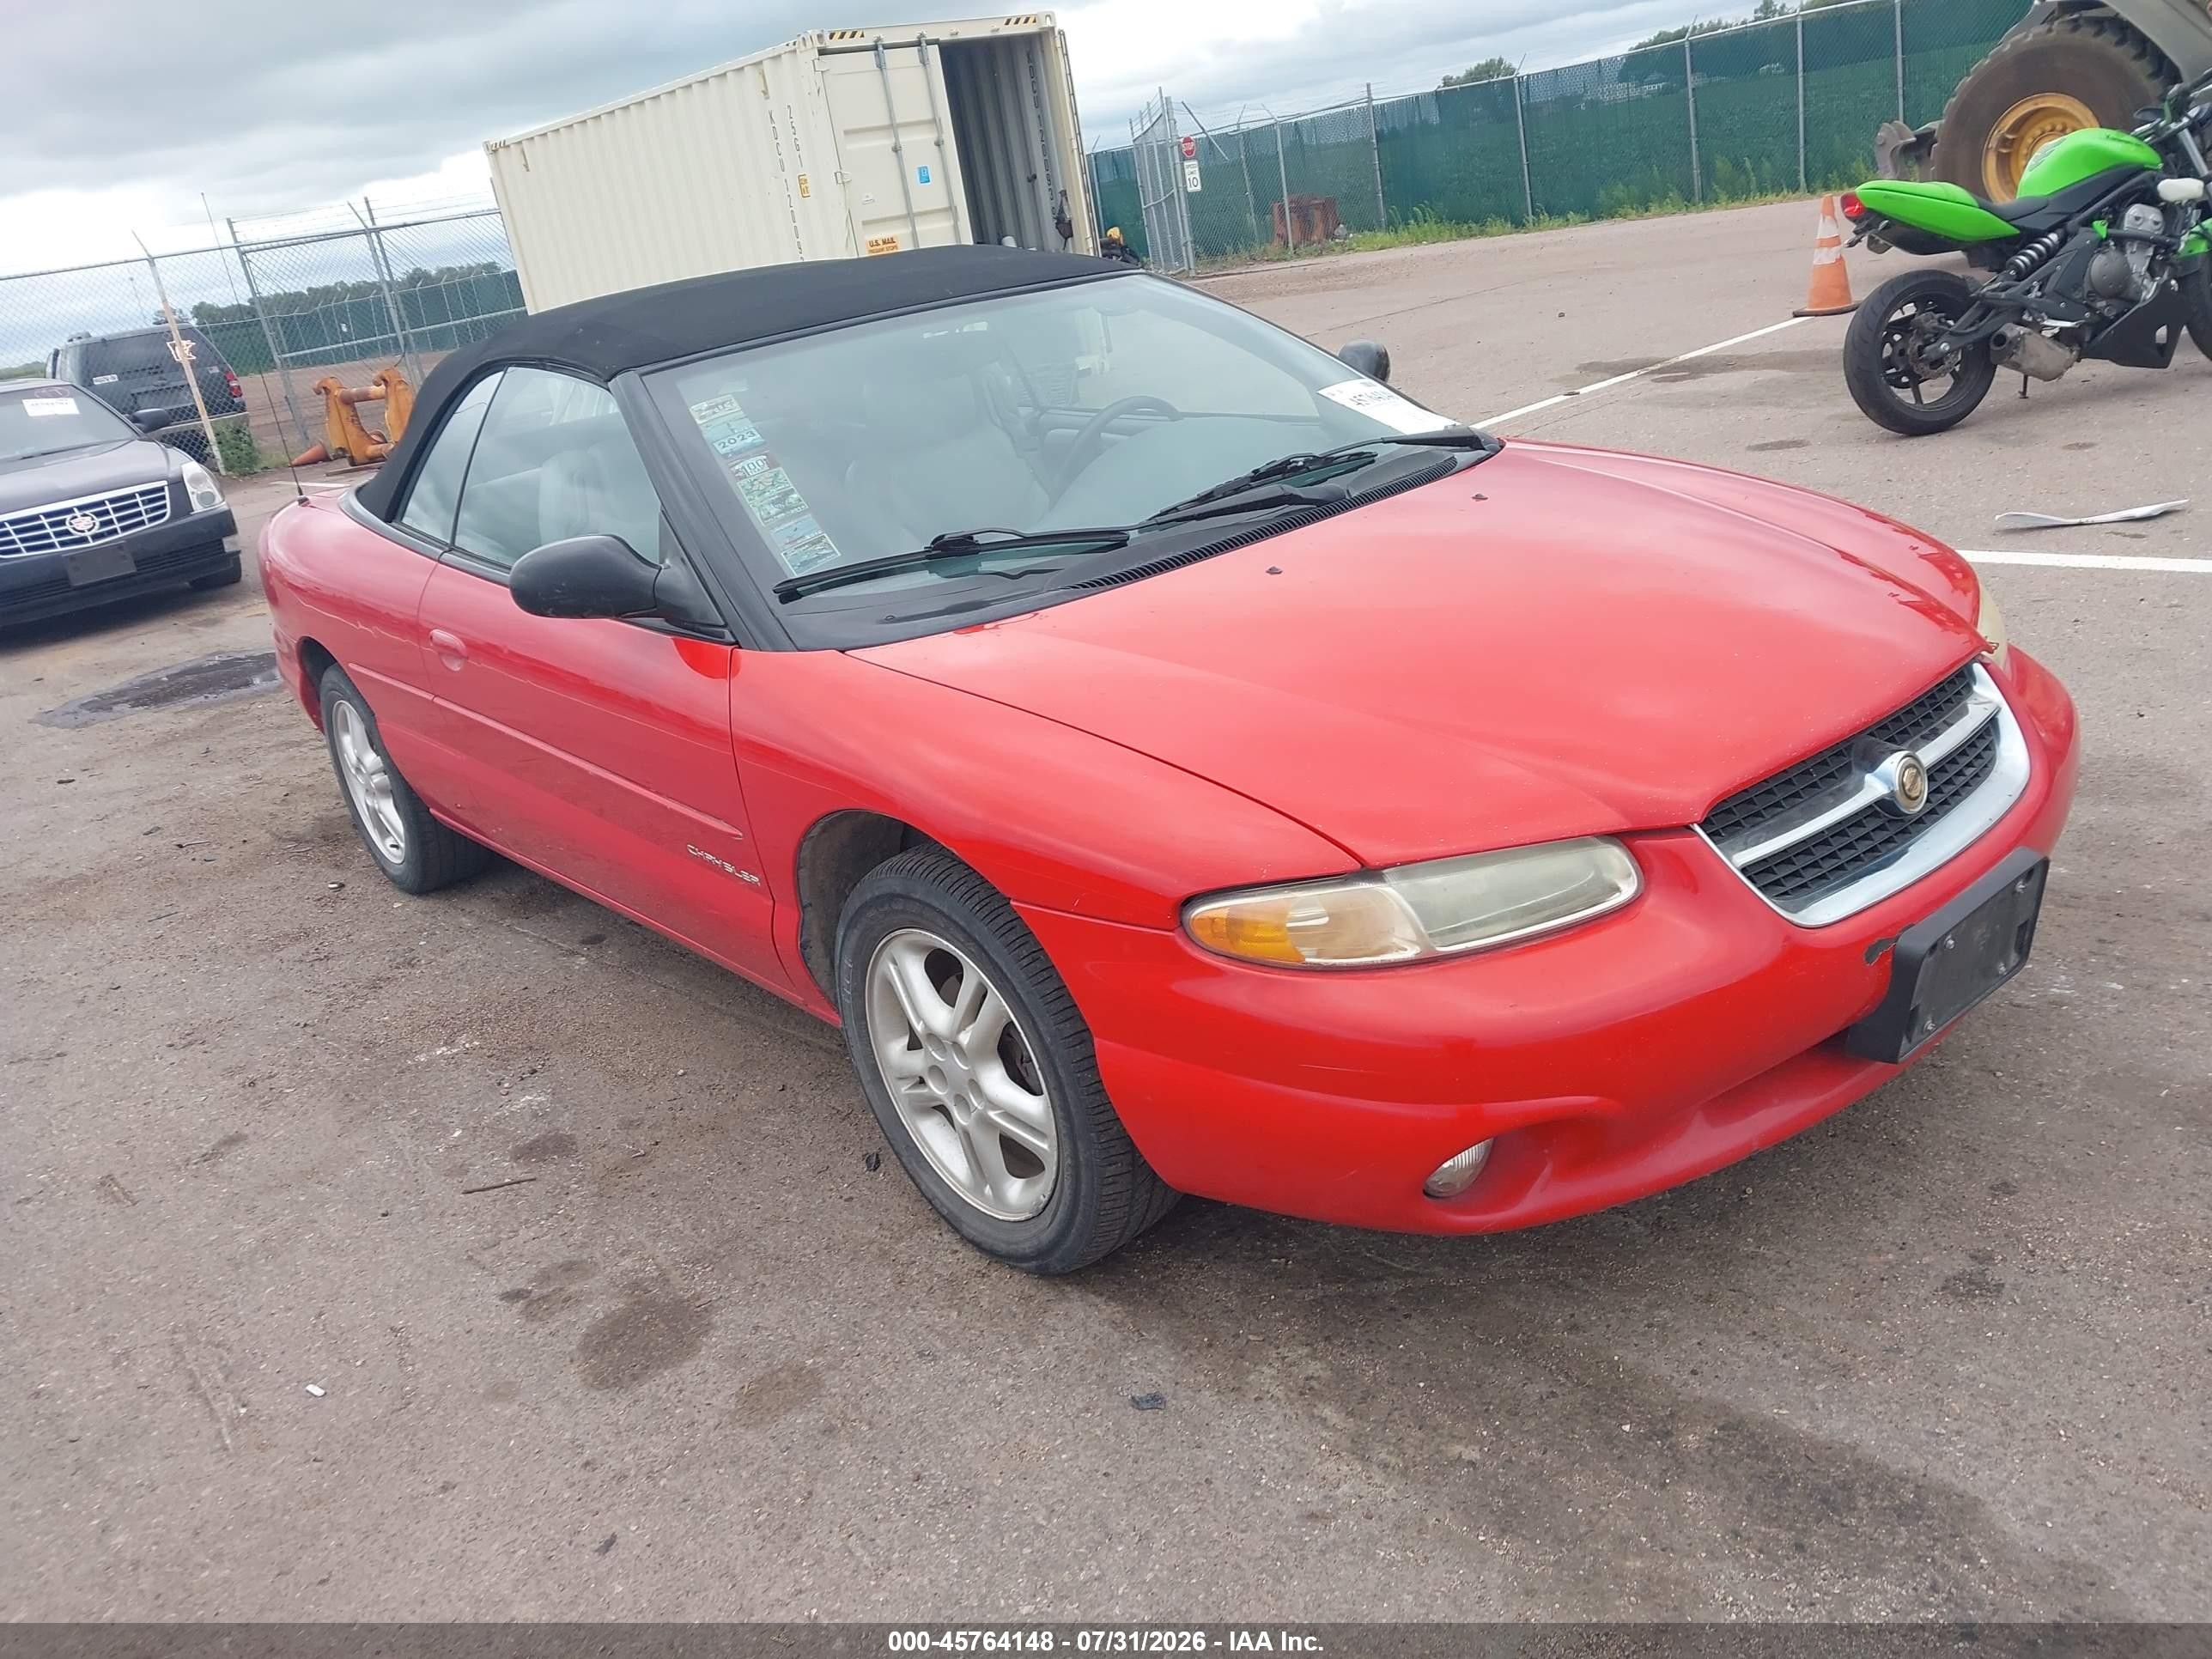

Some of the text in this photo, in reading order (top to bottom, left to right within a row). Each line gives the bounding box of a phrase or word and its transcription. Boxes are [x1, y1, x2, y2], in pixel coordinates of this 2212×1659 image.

[1188, 177, 1199, 188] 10
[718, 430, 756, 449] 2023
[687, 843, 761, 887] CHRYSLER
